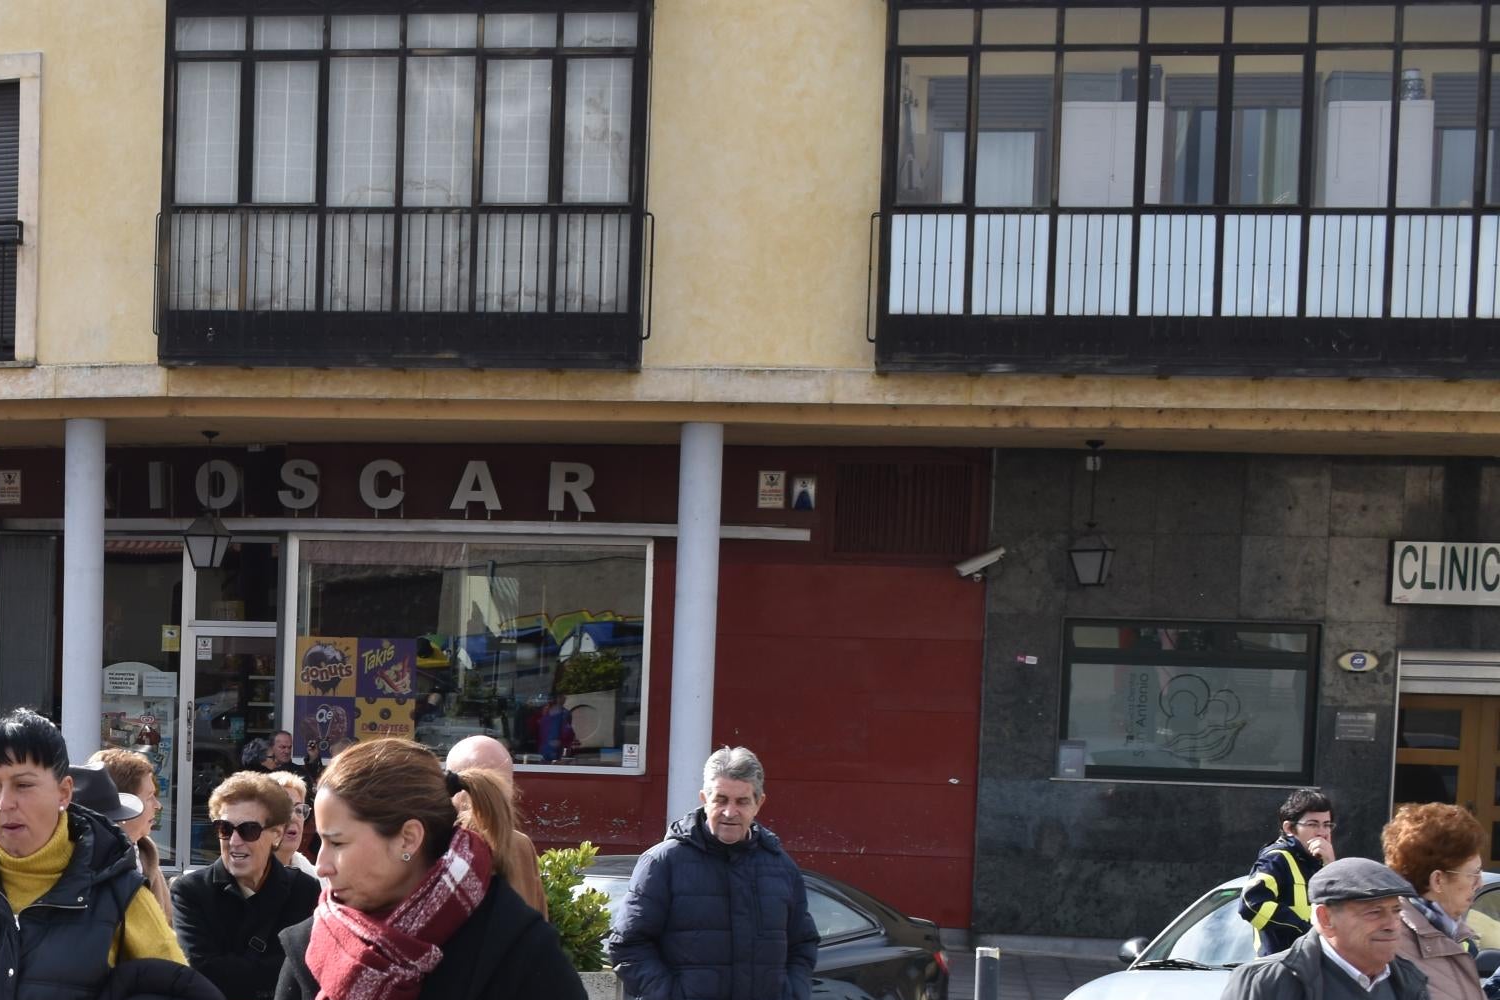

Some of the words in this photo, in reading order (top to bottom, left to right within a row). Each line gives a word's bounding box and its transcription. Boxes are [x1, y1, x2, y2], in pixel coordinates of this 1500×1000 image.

[301, 662, 354, 683] donuts
[362, 644, 396, 674] Takis
[1136, 672, 1149, 728] Antonio
